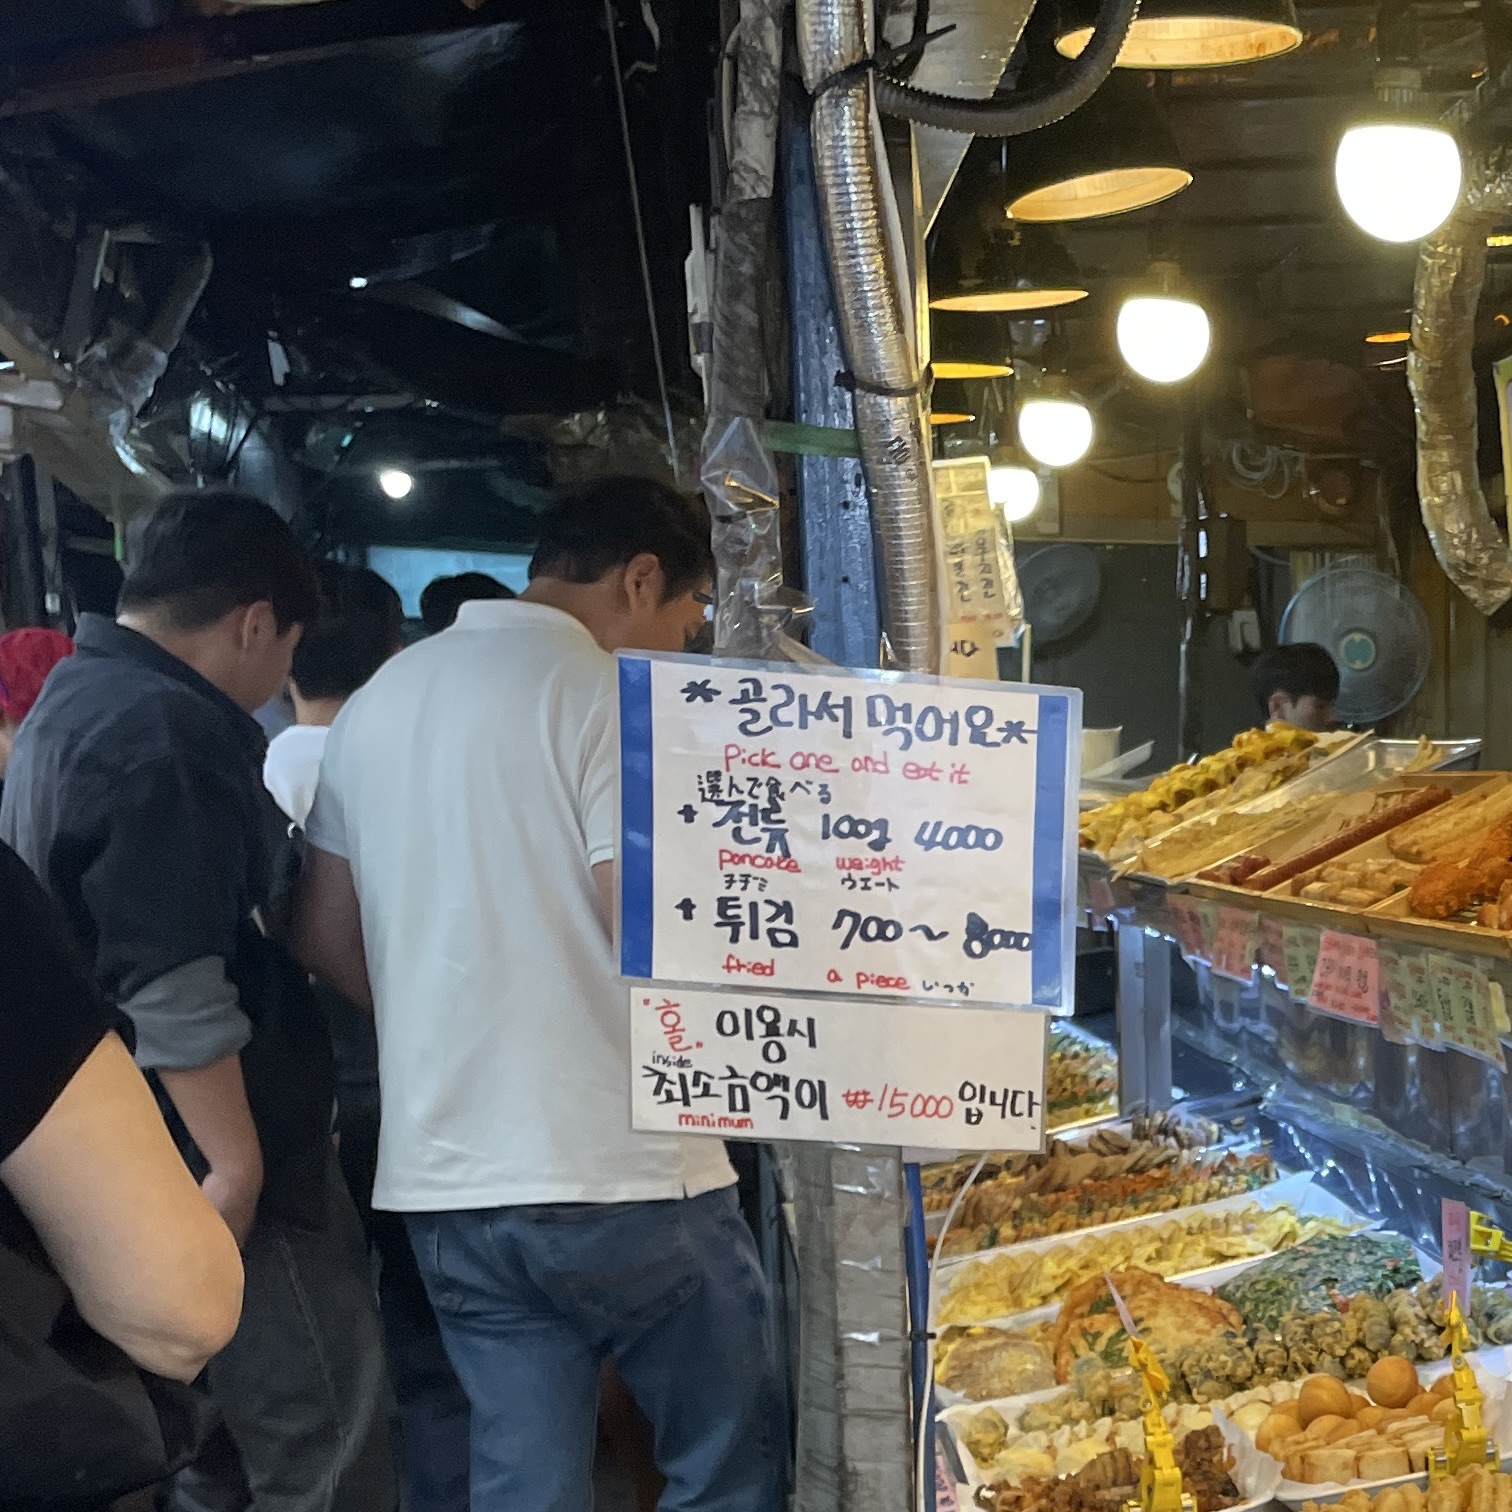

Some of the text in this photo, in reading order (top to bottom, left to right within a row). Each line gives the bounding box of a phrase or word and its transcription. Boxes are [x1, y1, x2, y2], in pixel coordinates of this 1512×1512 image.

[724, 744, 971, 785] Pick one and eat it
[697, 770, 832, 804] 選んで食べる
[914, 820, 1004, 852] 4000
[836, 855, 906, 877] weight
[721, 954, 776, 977] fried
[856, 973, 911, 990] piece
[716, 1004, 817, 1064] 이용시
[651, 1050, 693, 1069] inside
[642, 1065, 829, 1121] 최소금액이
[678, 1112, 754, 1130] minimum
